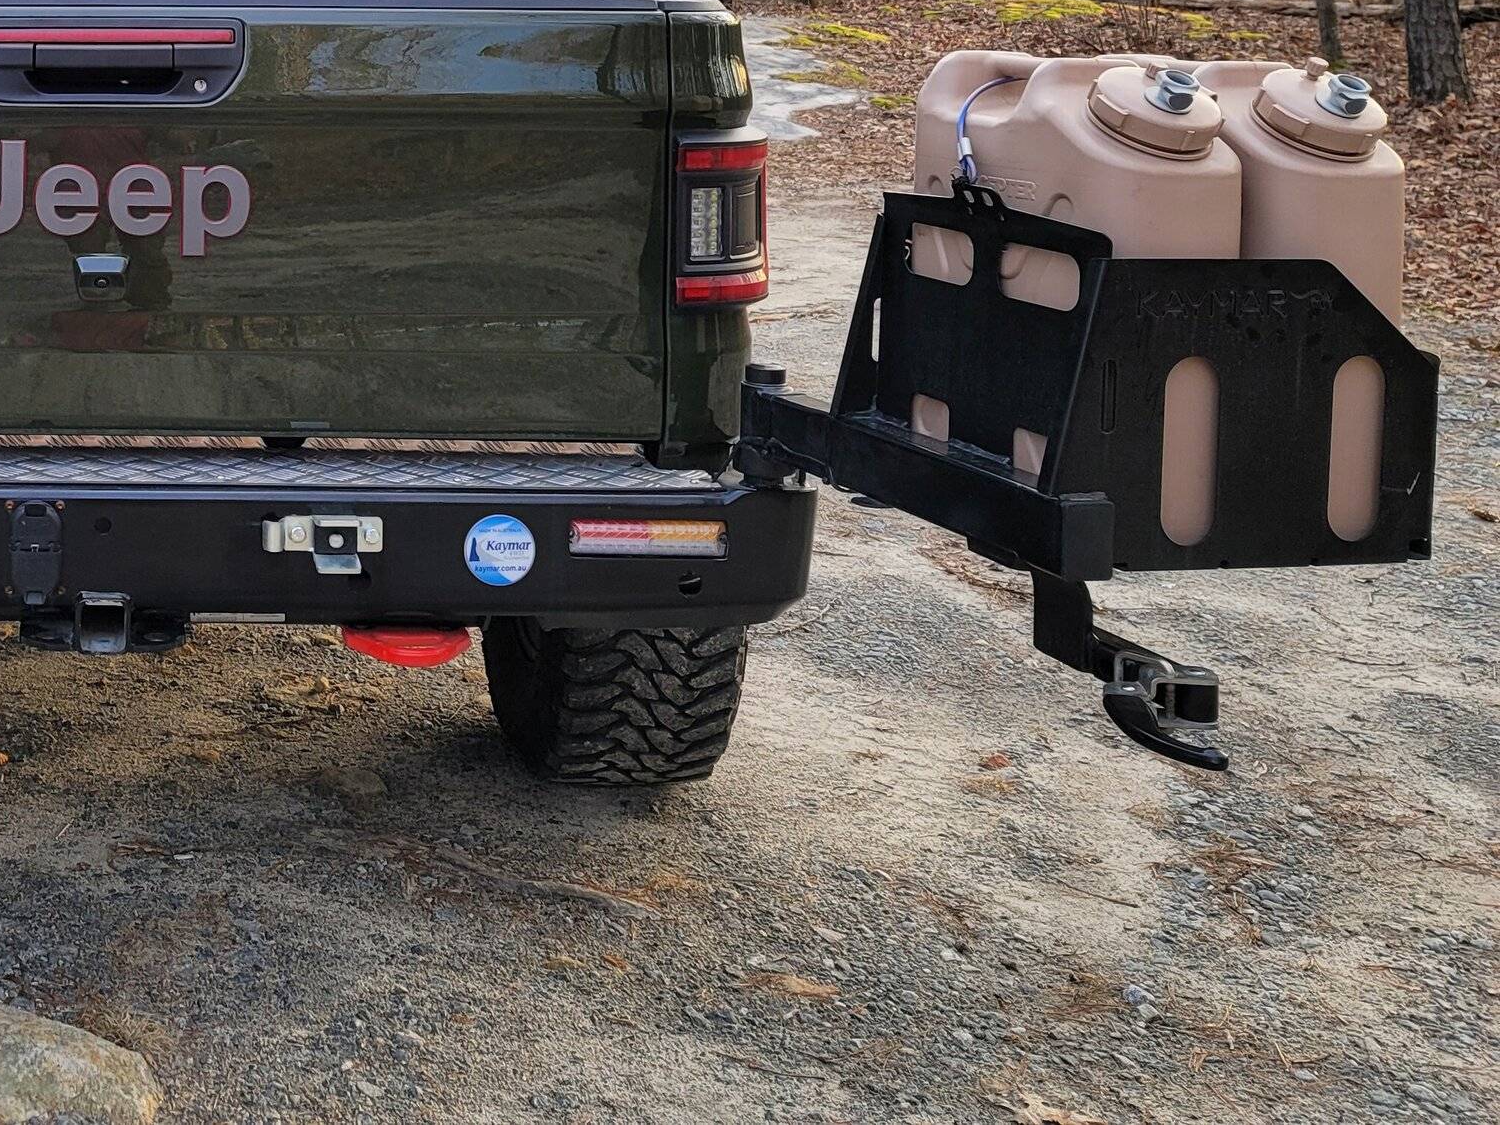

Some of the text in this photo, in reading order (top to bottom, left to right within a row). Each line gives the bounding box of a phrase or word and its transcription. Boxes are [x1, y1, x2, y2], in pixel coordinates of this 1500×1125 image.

[1132, 289, 1288, 319] KAYMAR
[486, 540, 531, 554] Kaymar
[475, 565, 526, 573] kaymar.com.au
